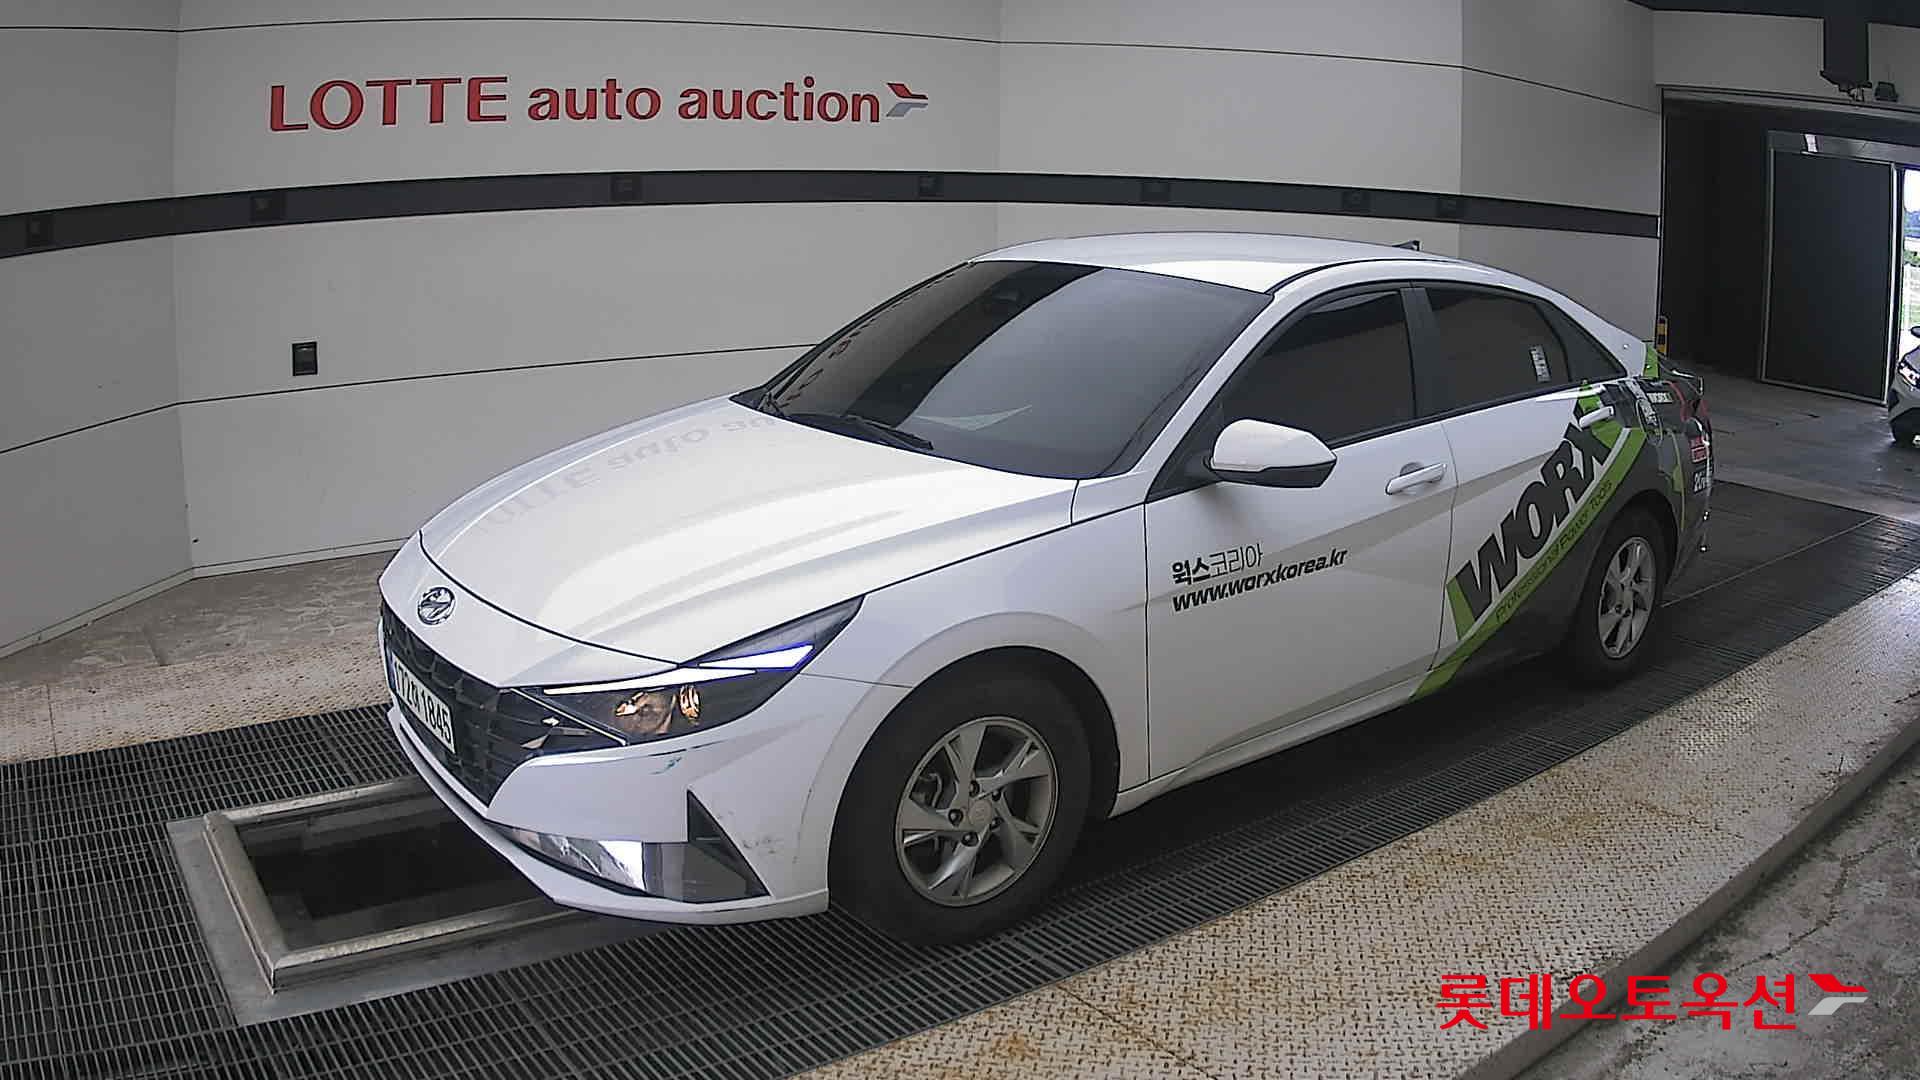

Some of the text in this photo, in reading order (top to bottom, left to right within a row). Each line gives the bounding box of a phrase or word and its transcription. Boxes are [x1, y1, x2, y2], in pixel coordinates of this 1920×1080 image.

[269, 76, 881, 131] LOTTE auto auction
[1455, 397, 1612, 621] WORX
[1172, 543, 1263, 585] 웍스코리아
[1173, 547, 1347, 612] www.worxkorea.kr
[421, 689, 452, 745] 1845
